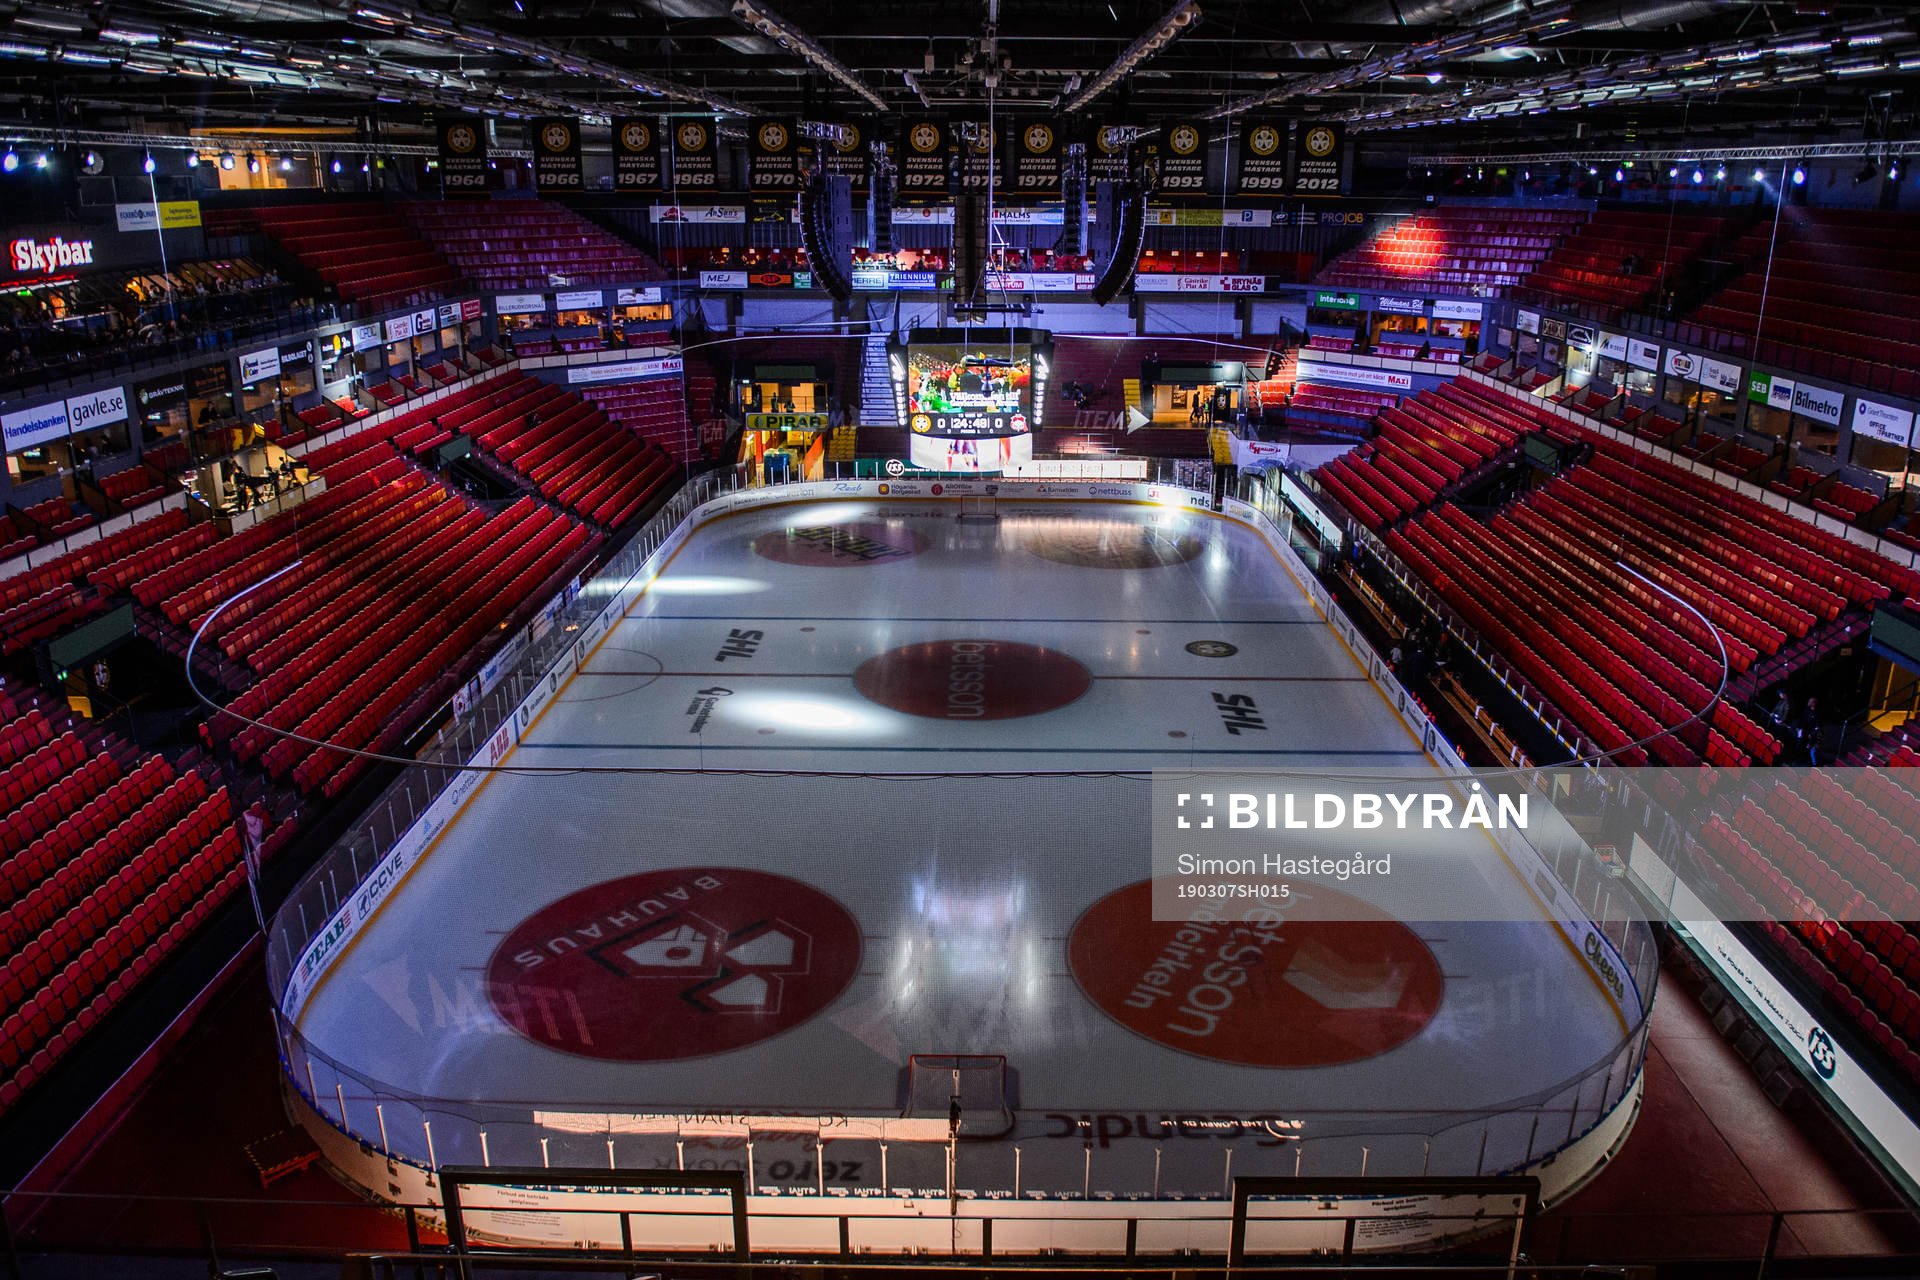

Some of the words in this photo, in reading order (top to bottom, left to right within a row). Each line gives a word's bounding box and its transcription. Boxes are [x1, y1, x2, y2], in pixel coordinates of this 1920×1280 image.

[444, 174, 486, 186] 1964
[538, 173, 580, 186] 1966
[617, 172, 658, 185] 1967
[674, 173, 716, 186] 1968
[754, 173, 796, 186] 1970
[904, 174, 945, 187] 1972
[1018, 175, 1059, 187] 1977
[1162, 176, 1204, 188] 1993
[1240, 176, 1284, 189] 1999
[1296, 178, 1340, 190] 2012
[1321, 212, 1364, 224] PROJOB
[11, 237, 94, 274] Skybar
[707, 274, 730, 282] MEJ
[1751, 380, 1767, 394] SEB
[1794, 390, 1838, 417] Bilmetro
[72, 396, 124, 426] gavle.se
[4, 414, 67, 439] Handelsbanken
[938, 418, 946, 428] 0
[995, 418, 1003, 428] 0
[1098, 488, 1132, 496] nettbuss
[714, 628, 764, 662] SHL
[948, 641, 987, 718] betsson
[1210, 692, 1268, 736] SHL
[490, 727, 510, 766] ABB
[514, 875, 724, 969] BAUHAUS
[302, 914, 346, 978] PEAB
[1584, 932, 1624, 999] Cheers
[1810, 1033, 1836, 1072] ISS
